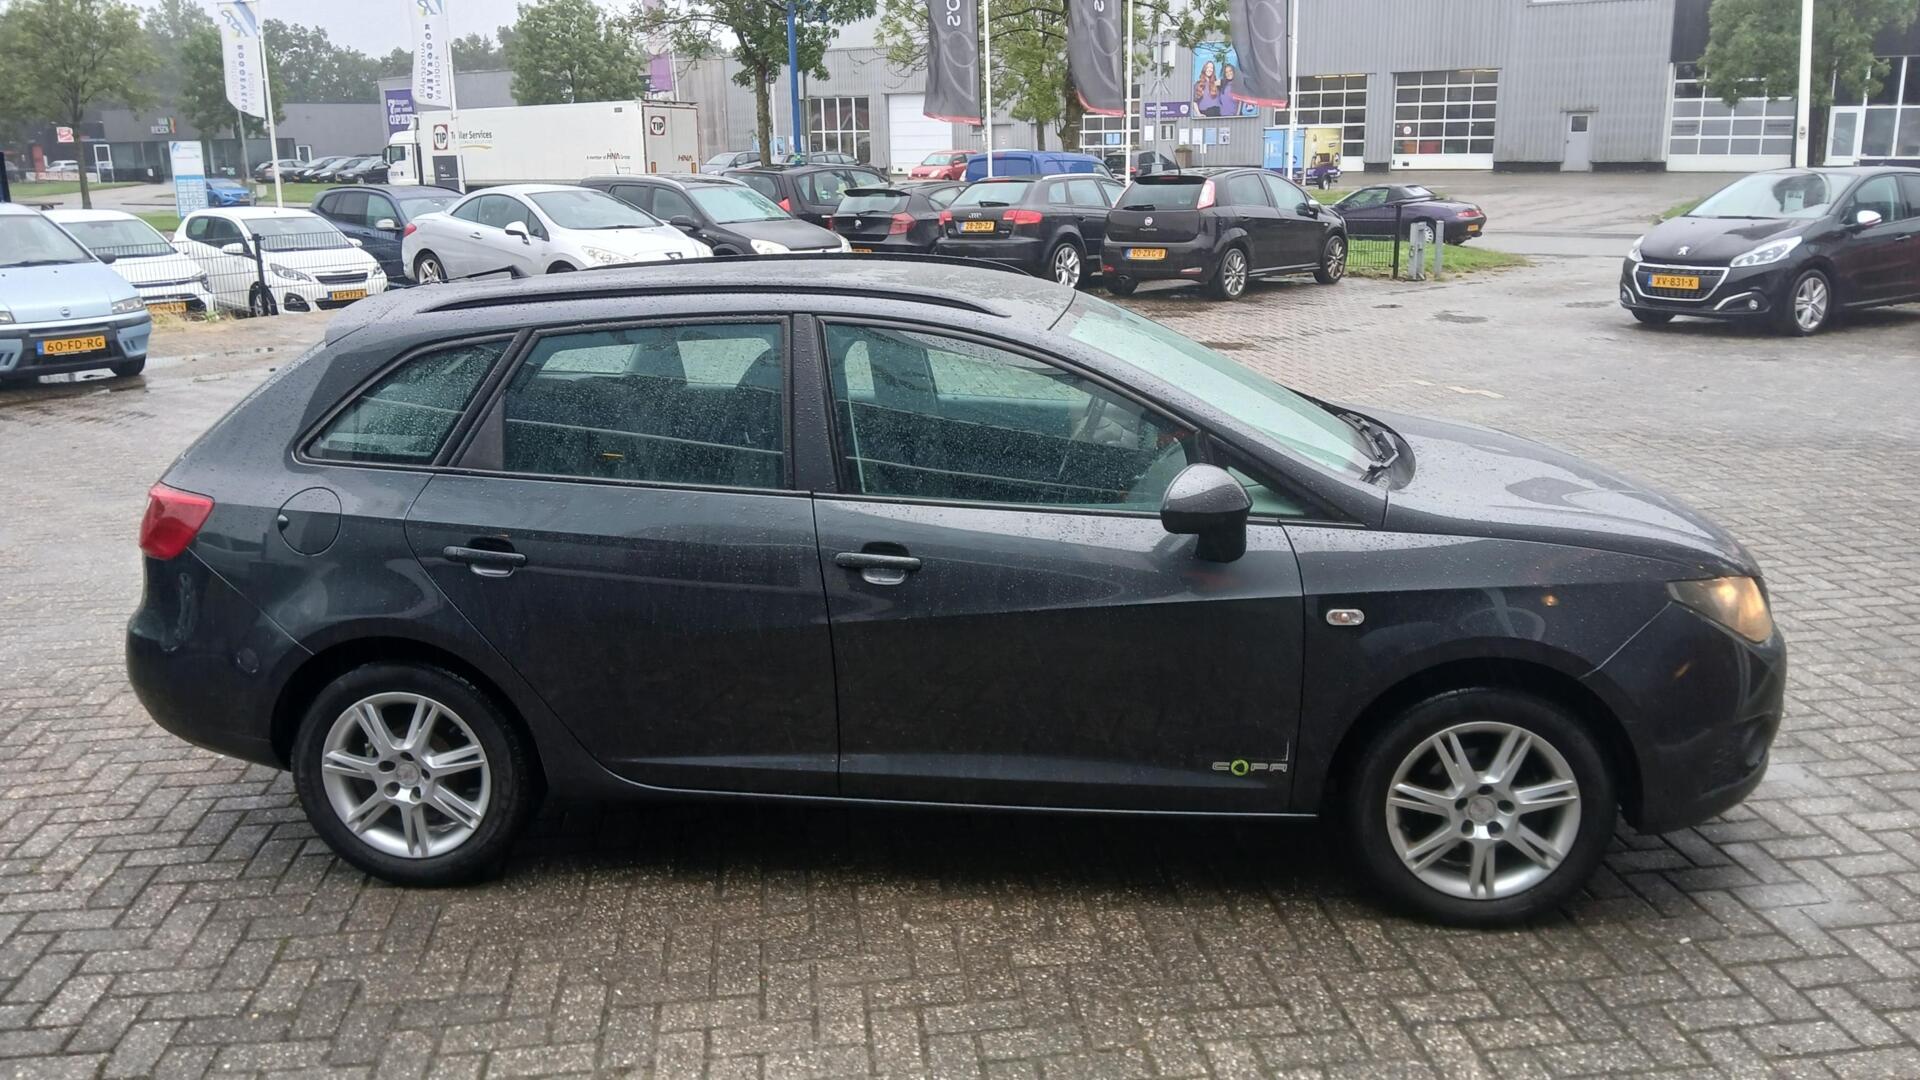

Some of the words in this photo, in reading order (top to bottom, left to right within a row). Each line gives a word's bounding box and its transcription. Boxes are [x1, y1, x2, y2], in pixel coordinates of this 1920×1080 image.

[652, 122, 664, 131] TIP
[435, 132, 447, 144] TIP
[468, 130, 492, 139] Services
[1655, 277, 1694, 287] XV-831-X
[47, 337, 103, 352] 60-FD-RG
